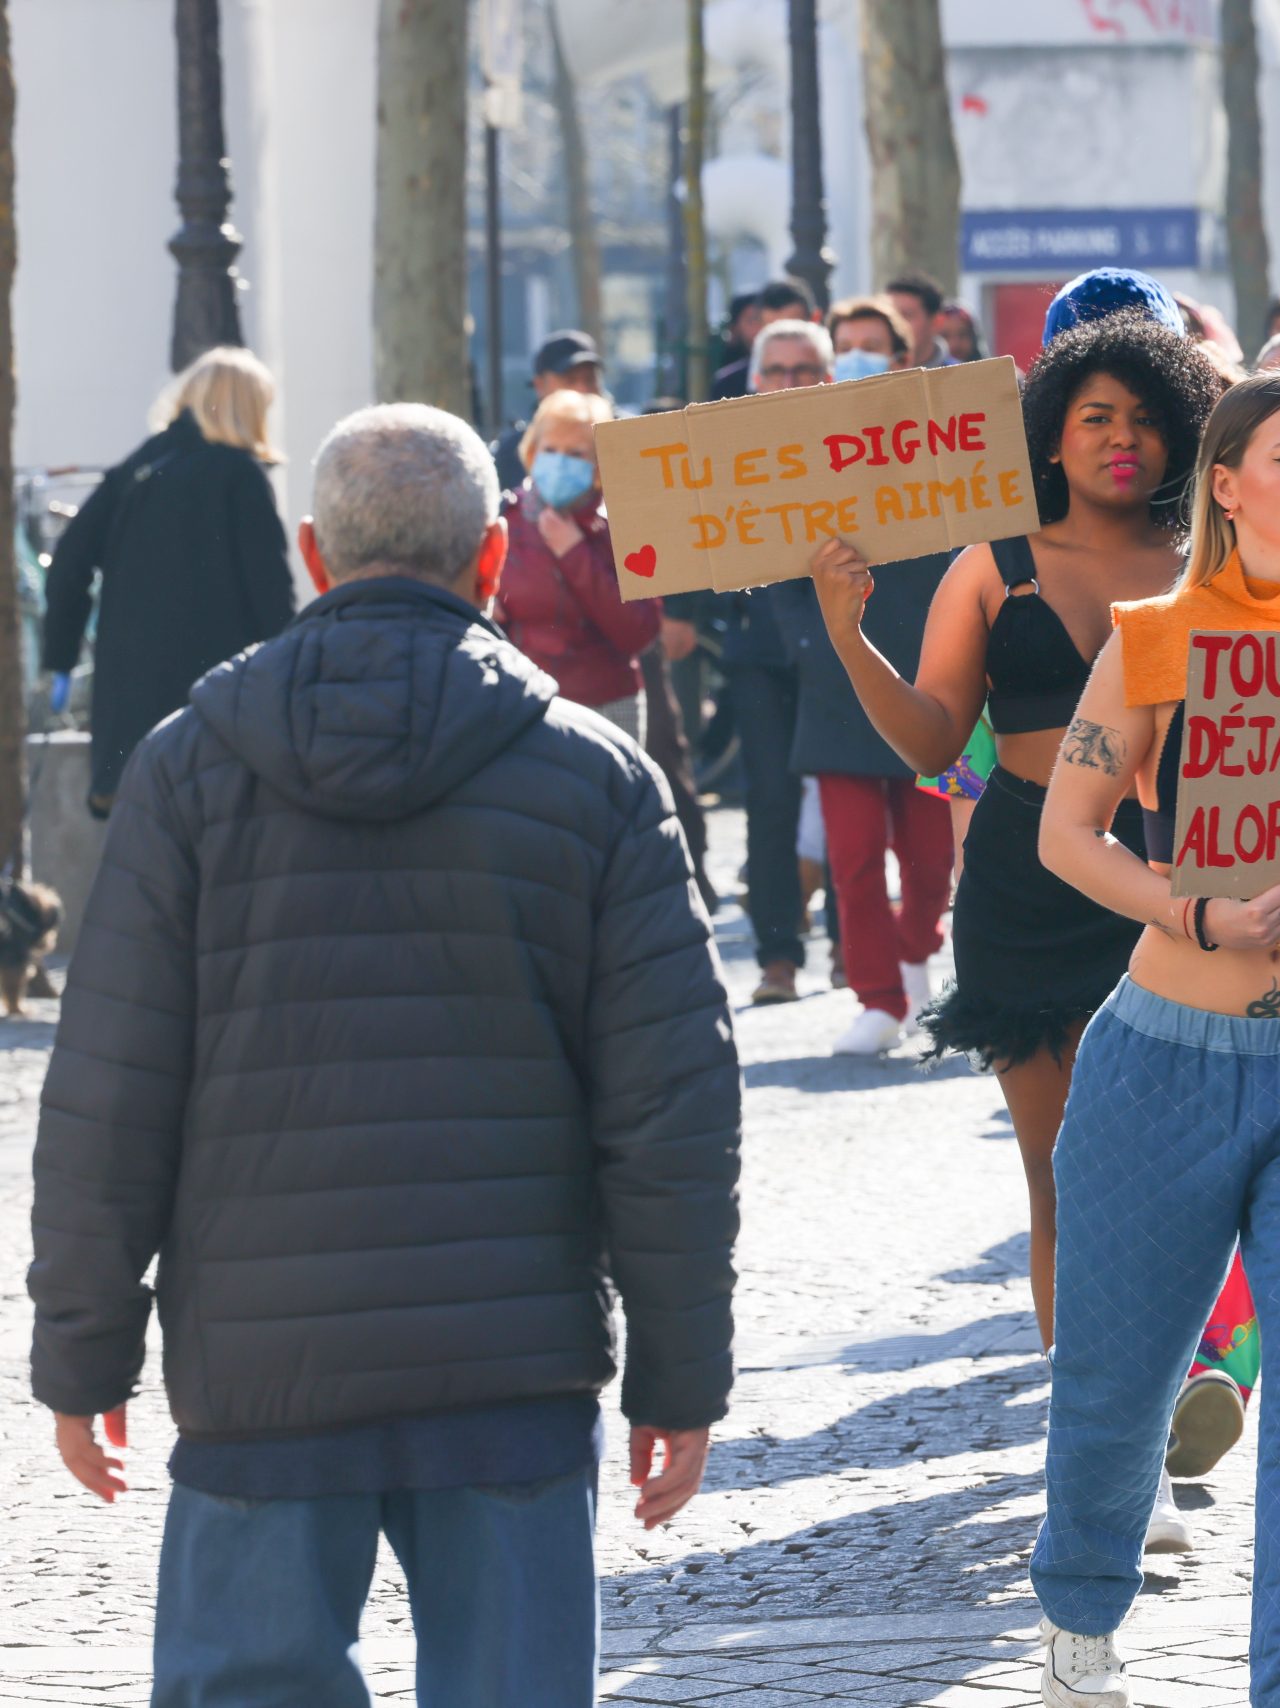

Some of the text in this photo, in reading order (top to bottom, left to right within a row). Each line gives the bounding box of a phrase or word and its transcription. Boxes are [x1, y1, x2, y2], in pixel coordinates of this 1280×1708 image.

[640, 412, 986, 490] TU ES DIGNE
[689, 459, 1024, 549] D'ÊTRE AIMÉE
